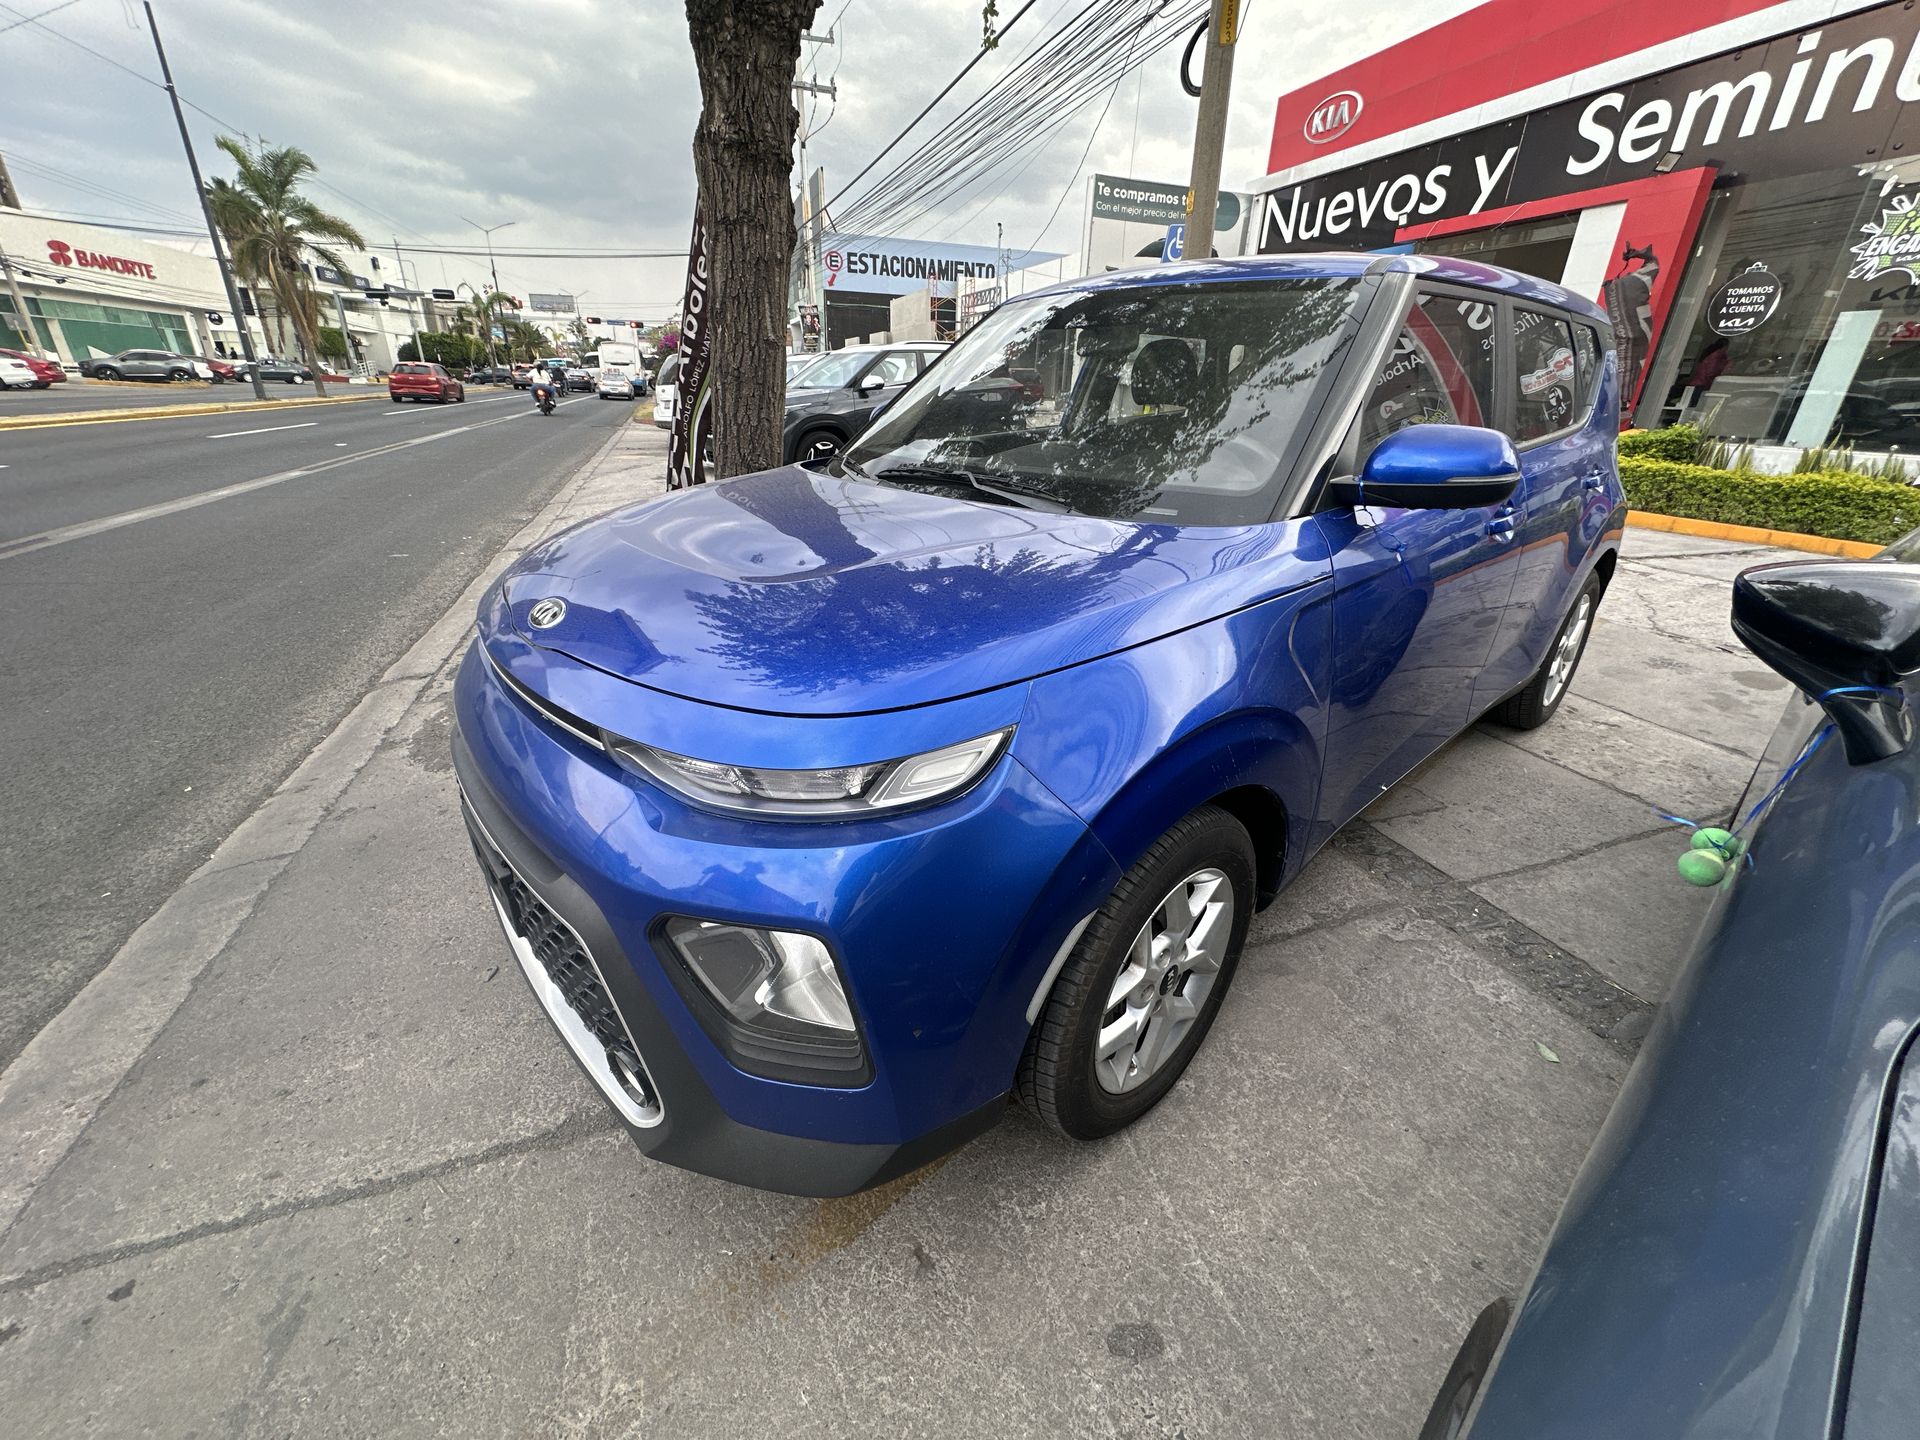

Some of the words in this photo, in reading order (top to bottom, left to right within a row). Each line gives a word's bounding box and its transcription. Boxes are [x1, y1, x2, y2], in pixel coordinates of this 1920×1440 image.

[1311, 99, 1350, 136] KIA
[1097, 181, 1111, 196] Te
[1113, 188, 1179, 204] compramos
[1259, 163, 1452, 250] Nuevos
[1467, 146, 1518, 215] y
[1095, 201, 1112, 211] Con
[1113, 203, 1120, 212] el
[1121, 206, 1142, 216] mejor
[1143, 208, 1167, 218] precio
[1168, 210, 1180, 219] del
[73, 248, 157, 280] BANORTE
[846, 251, 996, 282] ESTACIONAMIENTO
[1726, 297, 1738, 305] TU
[1738, 295, 1766, 304] AUTO
[1727, 285, 1775, 296] TOMAMOS
[1728, 304, 1765, 313] CUENTA
